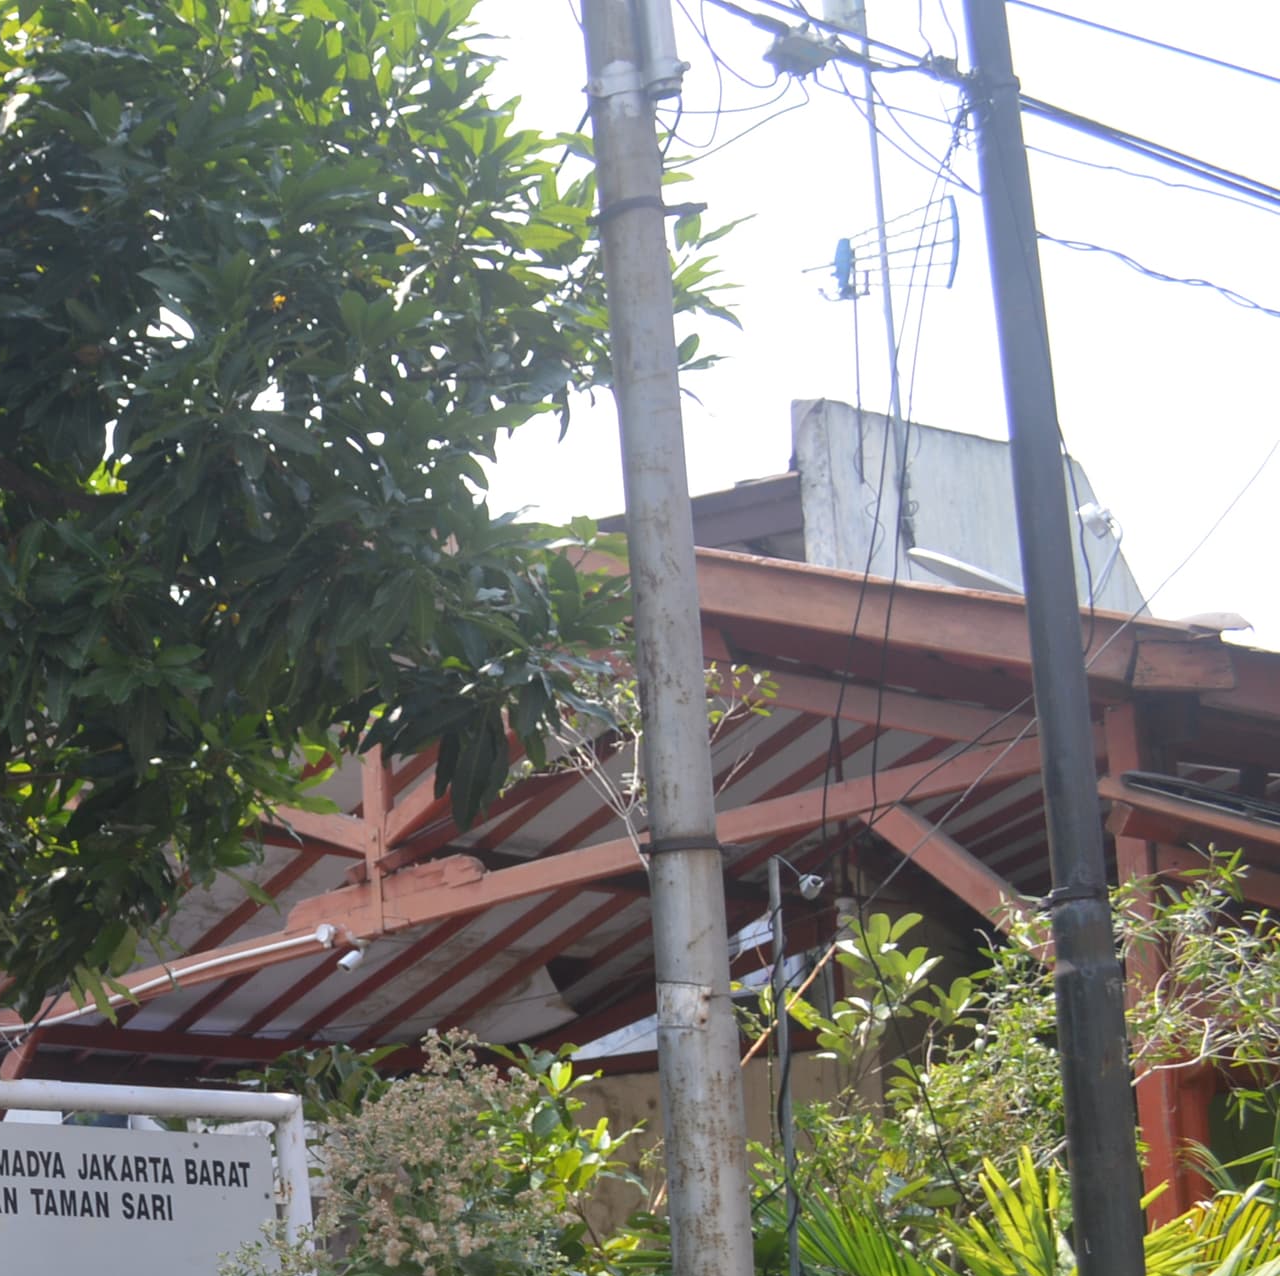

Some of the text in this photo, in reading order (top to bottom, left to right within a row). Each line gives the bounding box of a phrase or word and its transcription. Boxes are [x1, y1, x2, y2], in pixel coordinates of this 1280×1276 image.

[78, 1153, 174, 1184] JAKARTA
[184, 1158, 250, 1188] BARAT
[30, 1188, 110, 1219] TAMAN
[122, 1191, 174, 1221] SARI
